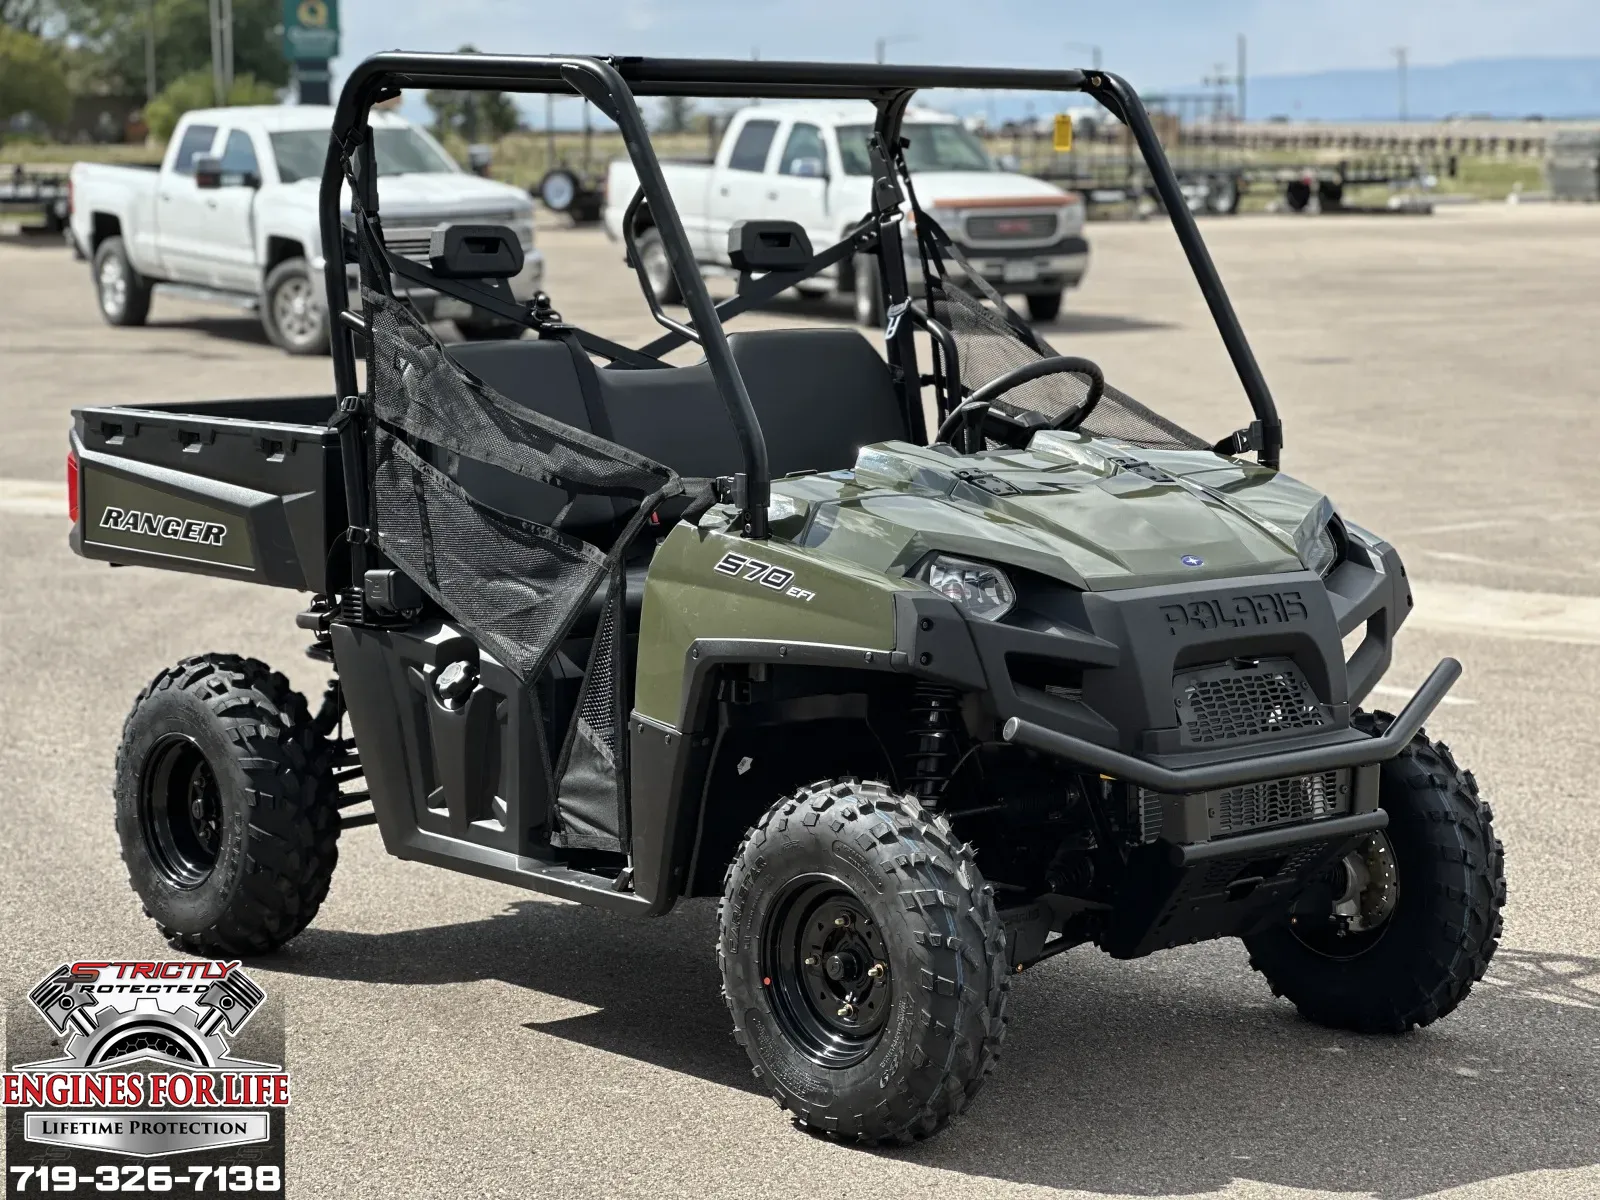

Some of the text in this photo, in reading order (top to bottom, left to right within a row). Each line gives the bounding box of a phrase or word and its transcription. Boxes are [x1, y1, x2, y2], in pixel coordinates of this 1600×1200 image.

[100, 506, 227, 546] RANGER
[714, 551, 816, 601] 570 EFI
[1160, 592, 1308, 635] POLARIS
